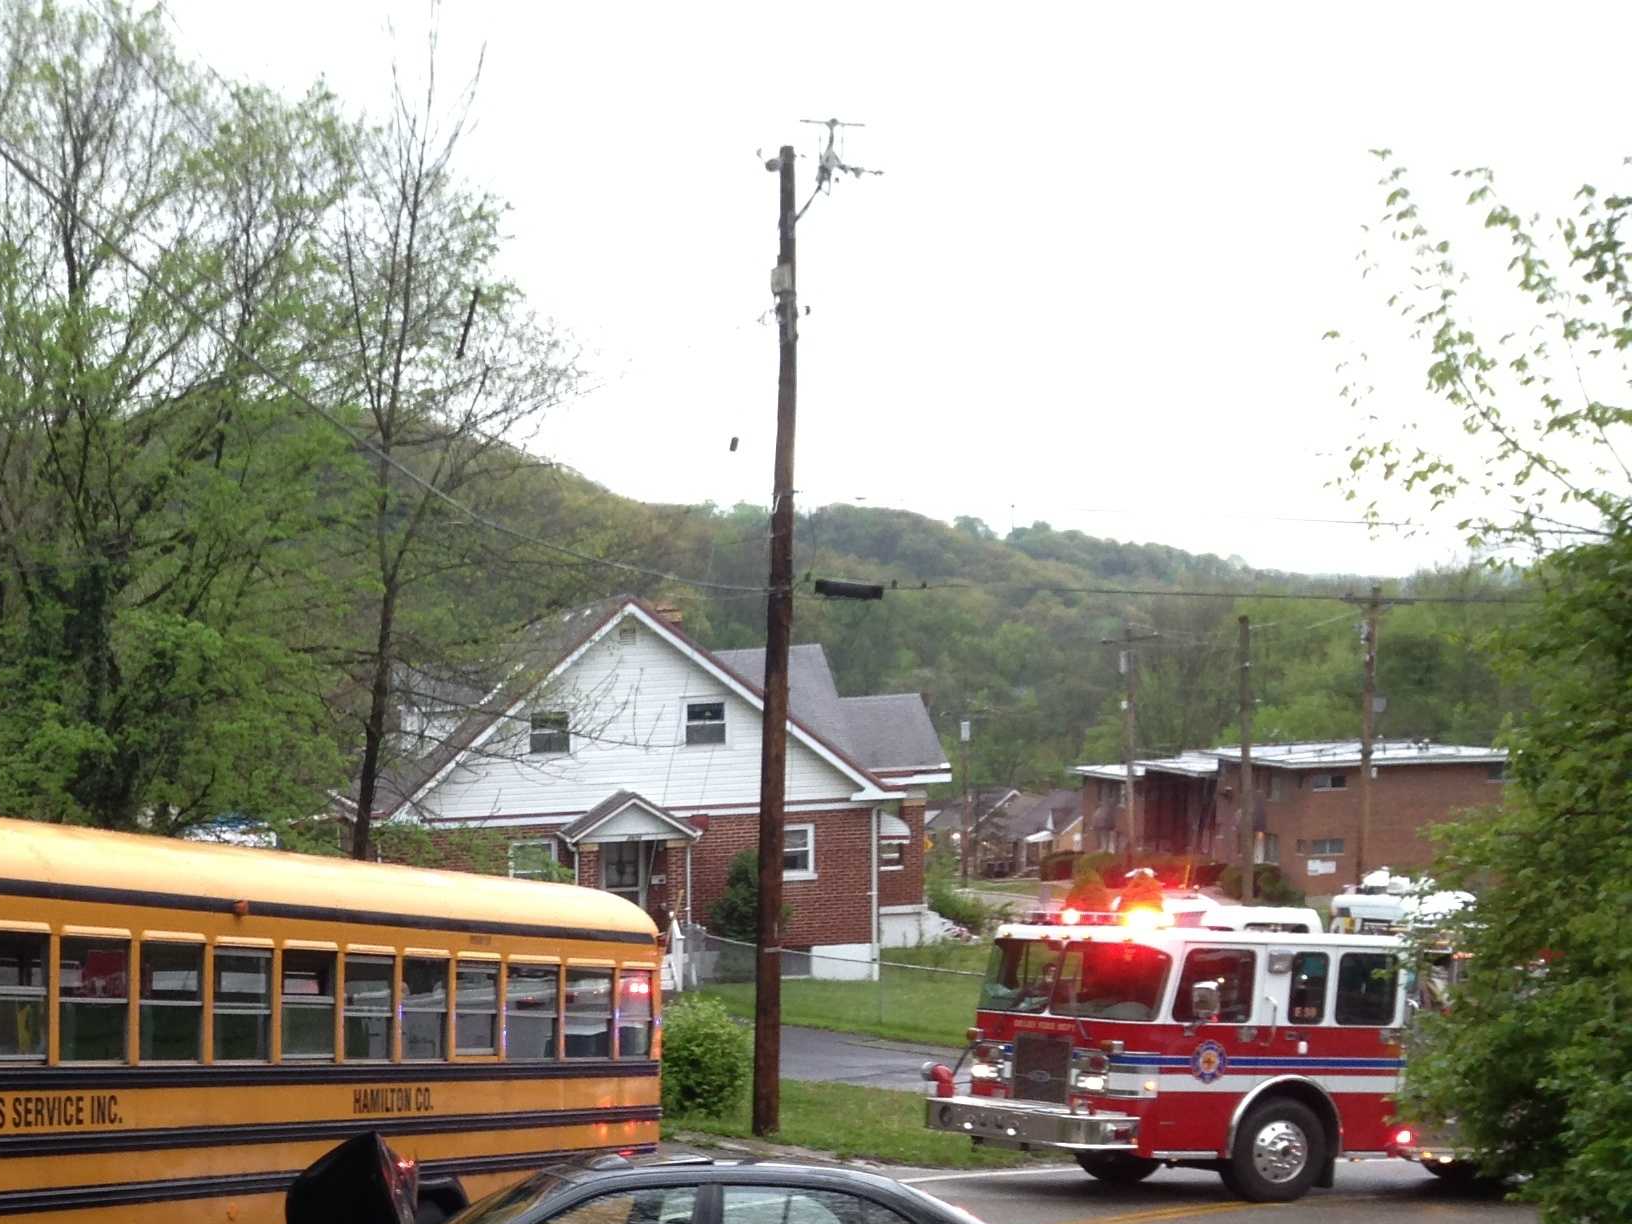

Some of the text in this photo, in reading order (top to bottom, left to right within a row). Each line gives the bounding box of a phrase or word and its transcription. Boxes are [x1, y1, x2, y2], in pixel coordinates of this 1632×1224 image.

[12, 1095, 85, 1128] SERVICE
[90, 1095, 123, 1125] INC.
[352, 1086, 434, 1114] HAMILTON CO.
